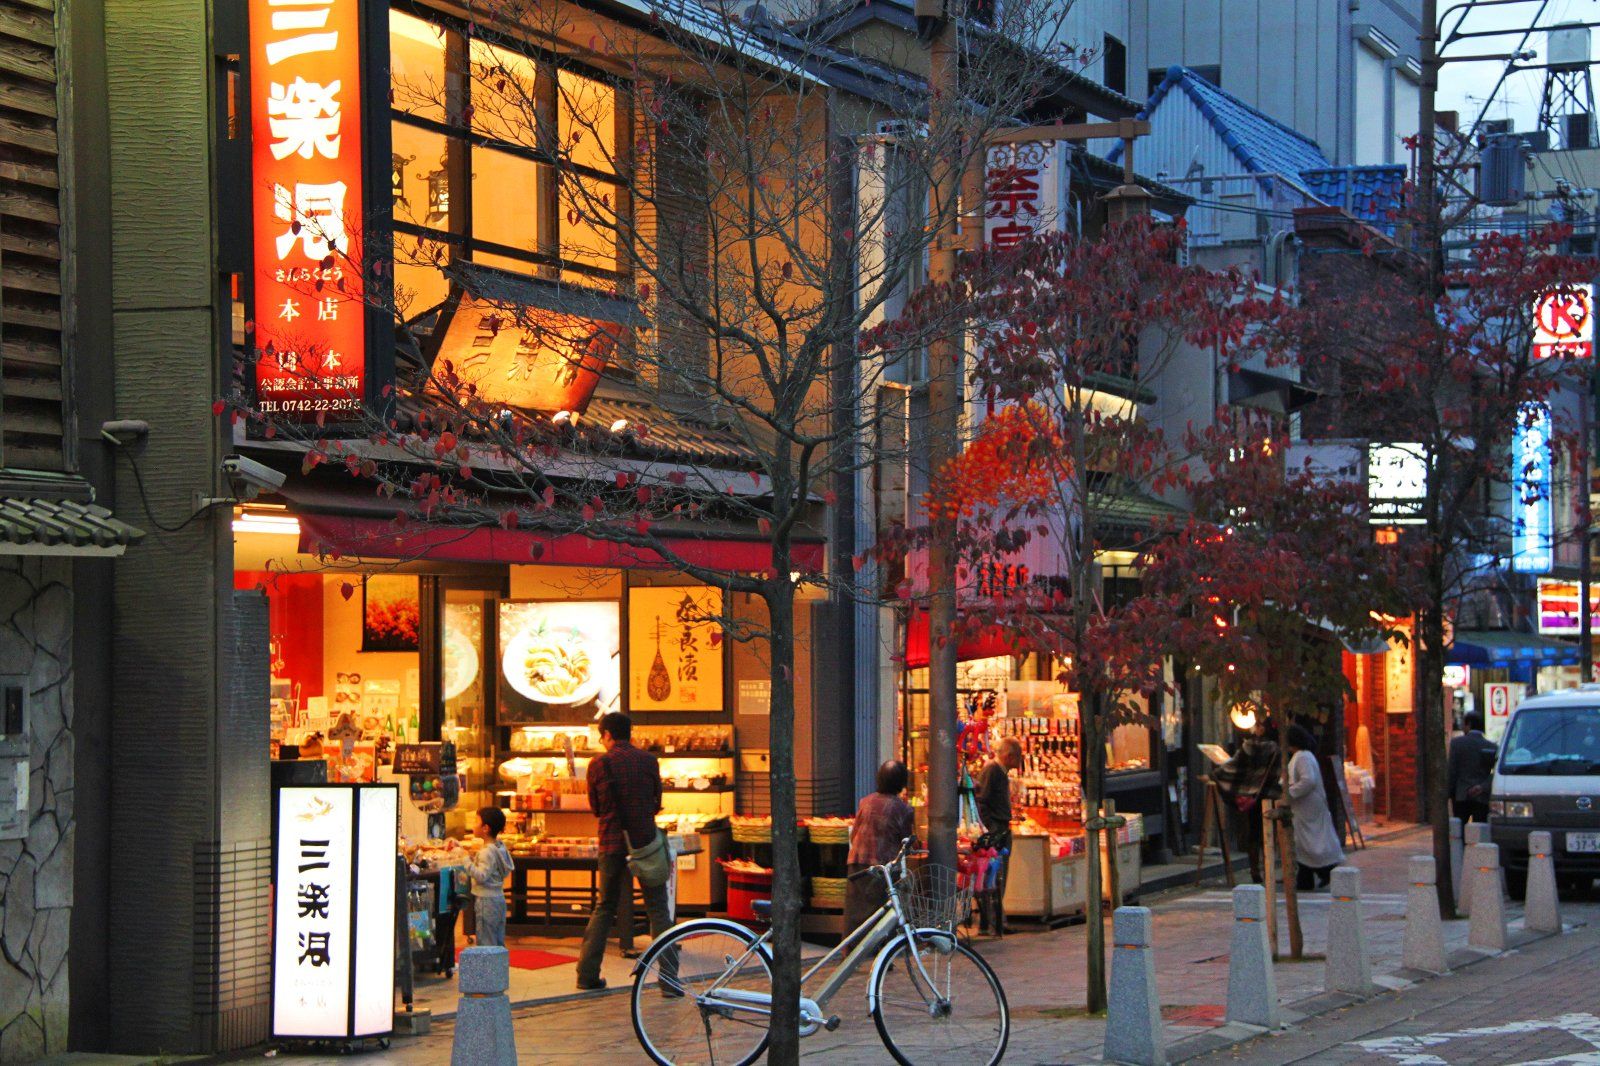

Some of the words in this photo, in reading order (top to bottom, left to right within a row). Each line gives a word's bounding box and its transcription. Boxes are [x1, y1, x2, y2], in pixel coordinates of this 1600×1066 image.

[275, 267, 343, 283] さんらくどう
[278, 297, 339, 322] 本店
[259, 401, 280, 412] TEL
[297, 839, 331, 967] 三楽洞
